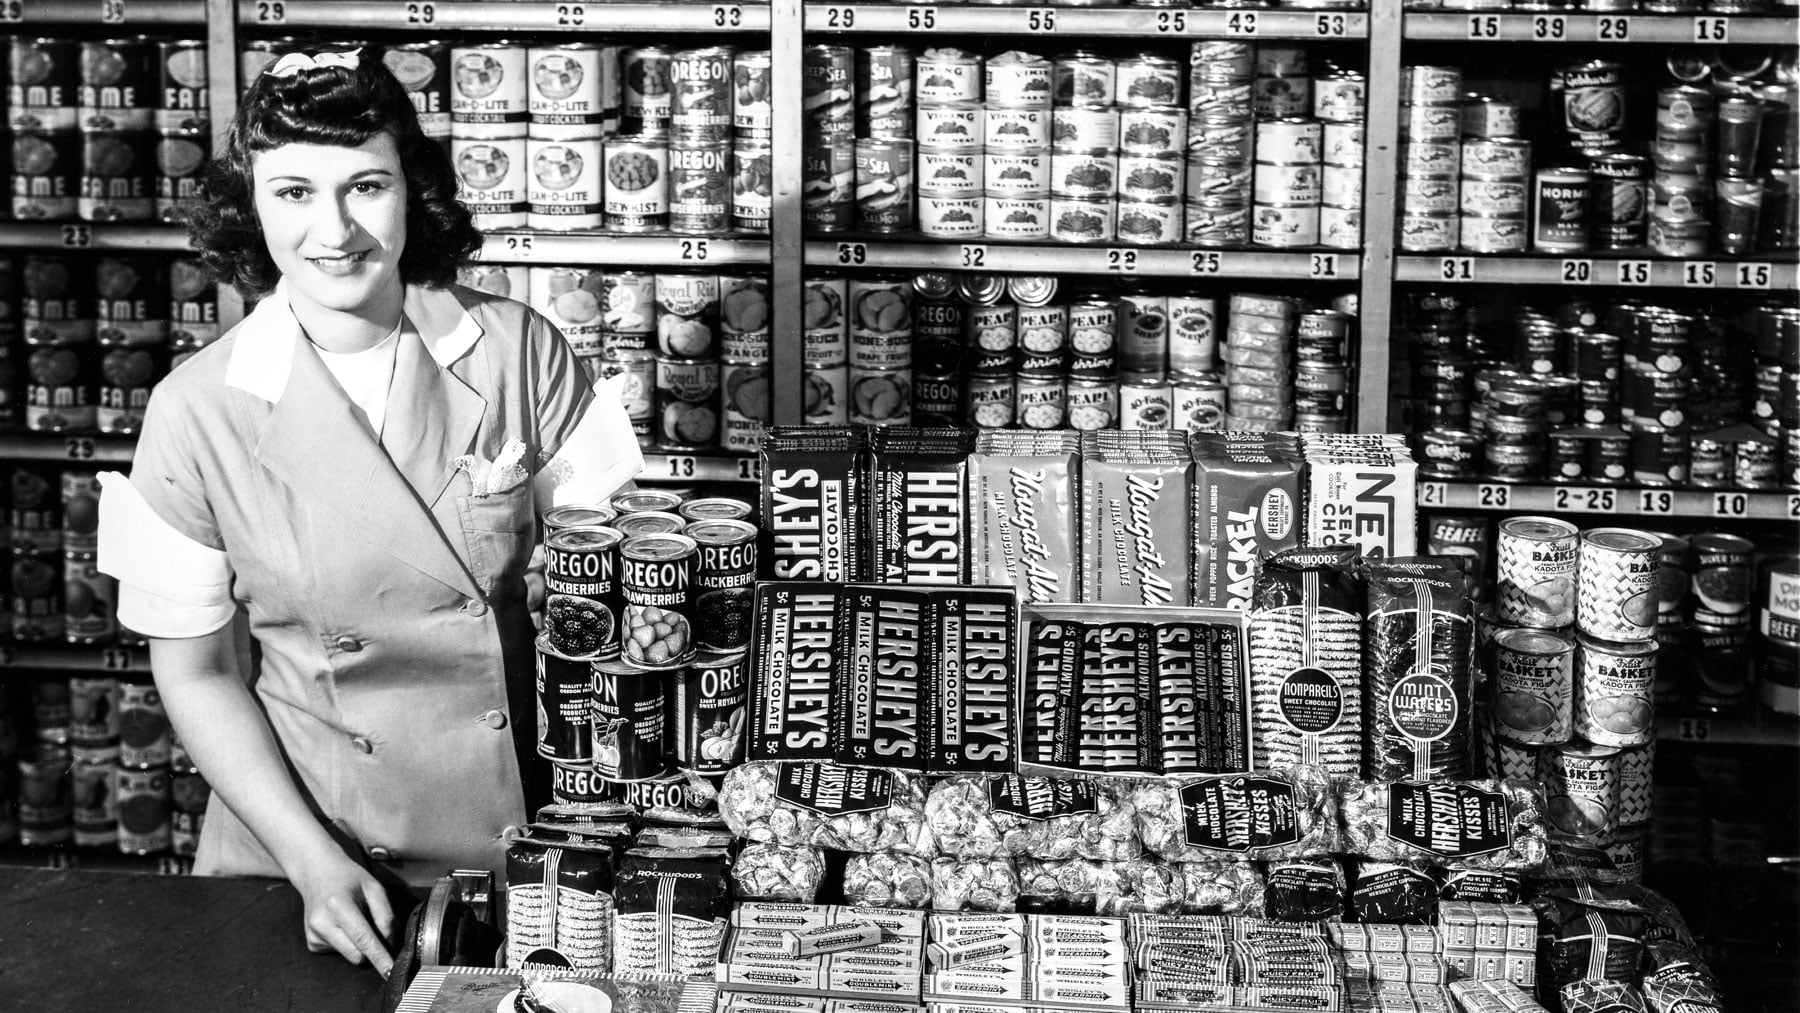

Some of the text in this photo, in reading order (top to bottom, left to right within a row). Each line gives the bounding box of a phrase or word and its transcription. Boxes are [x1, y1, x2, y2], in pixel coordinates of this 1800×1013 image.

[259, 2, 285, 21] 29
[408, 4, 434, 23] 29
[715, 8, 741, 26] 33
[828, 9, 854, 27] 29
[909, 9, 935, 28] 55
[1030, 11, 1054, 30] 55
[1471, 17, 1498, 37] 15
[1535, 18, 1564, 38] 39
[1600, 19, 1628, 39] 29
[1697, 20, 1726, 40] 15
[869, 158, 890, 173] SEA
[682, 241, 707, 260] 25
[839, 244, 866, 264] 39
[962, 246, 984, 266] 32
[1192, 253, 1219, 273] 25
[1313, 256, 1336, 276] 31
[1443, 260, 1472, 279] 31
[1564, 262, 1590, 281] 20
[1621, 264, 1647, 283] 15
[1686, 264, 1713, 284] 15
[1740, 266, 1768, 285] 15
[670, 458, 694, 476] 13
[1425, 485, 1444, 503] 21
[1481, 486, 1507, 506] 23
[1557, 489, 1614, 510] 2-25
[1643, 493, 1671, 511] 19
[1268, 493, 1279, 534] HERSHEY
[1717, 495, 1745, 514] 10
[826, 484, 839, 582] CHOCOLATE
[994, 491, 1017, 579] MILK CHOCOLATE
[1109, 499, 1131, 587] MILK CHOCOLATE
[1771, 621, 1797, 638] BEEF
[768, 612, 788, 730] MILK CHOCOLATE
[786, 594, 835, 748] HERSHEY'S
[855, 616, 872, 735] MILK CHOCOLATE
[1060, 640, 1076, 697] ALMONDS
[1137, 642, 1150, 700] ALMONDS
[1194, 642, 1208, 701] ALMONDS
[1222, 643, 1235, 702] ALMONDS
[1500, 664, 1556, 678] BASKET
[1598, 665, 1652, 679] BASKET
[874, 600, 919, 758] HERSHEY'S
[945, 621, 958, 741] MILK CHOCOLATE
[965, 603, 1010, 762] HERSHEY'S
[1531, 680, 1552, 688] FIGS
[1600, 680, 1634, 689] KADOTA
[1101, 627, 1138, 767] HERSHEY'S
[1157, 627, 1197, 768] HERSHEY'S
[1284, 682, 1338, 699] NONPAREILS
[1403, 683, 1444, 696] MINT
[717, 697, 737, 707] ROYAL
[1304, 698, 1338, 707] CHOCOLATE
[1395, 696, 1452, 713] WAFERS
[790, 767, 802, 786] MILK
[850, 770, 869, 800] KISSES
[1196, 801, 1209, 827] MILK
[1205, 787, 1222, 839] CHOCOLATE
[1219, 777, 1250, 847] HERSHEY'S
[1250, 789, 1272, 836] KISSES
[1402, 797, 1413, 822] MILK
[1413, 789, 1426, 838] CHOCOLATE
[1428, 783, 1460, 851] HERSHEY'S
[1463, 796, 1483, 840] KISSES
[637, 870, 703, 879] ROCKWOOD'S
[1374, 880, 1398, 891] CHOCOLATE
[749, 974, 795, 982] DOUBLEMINT
